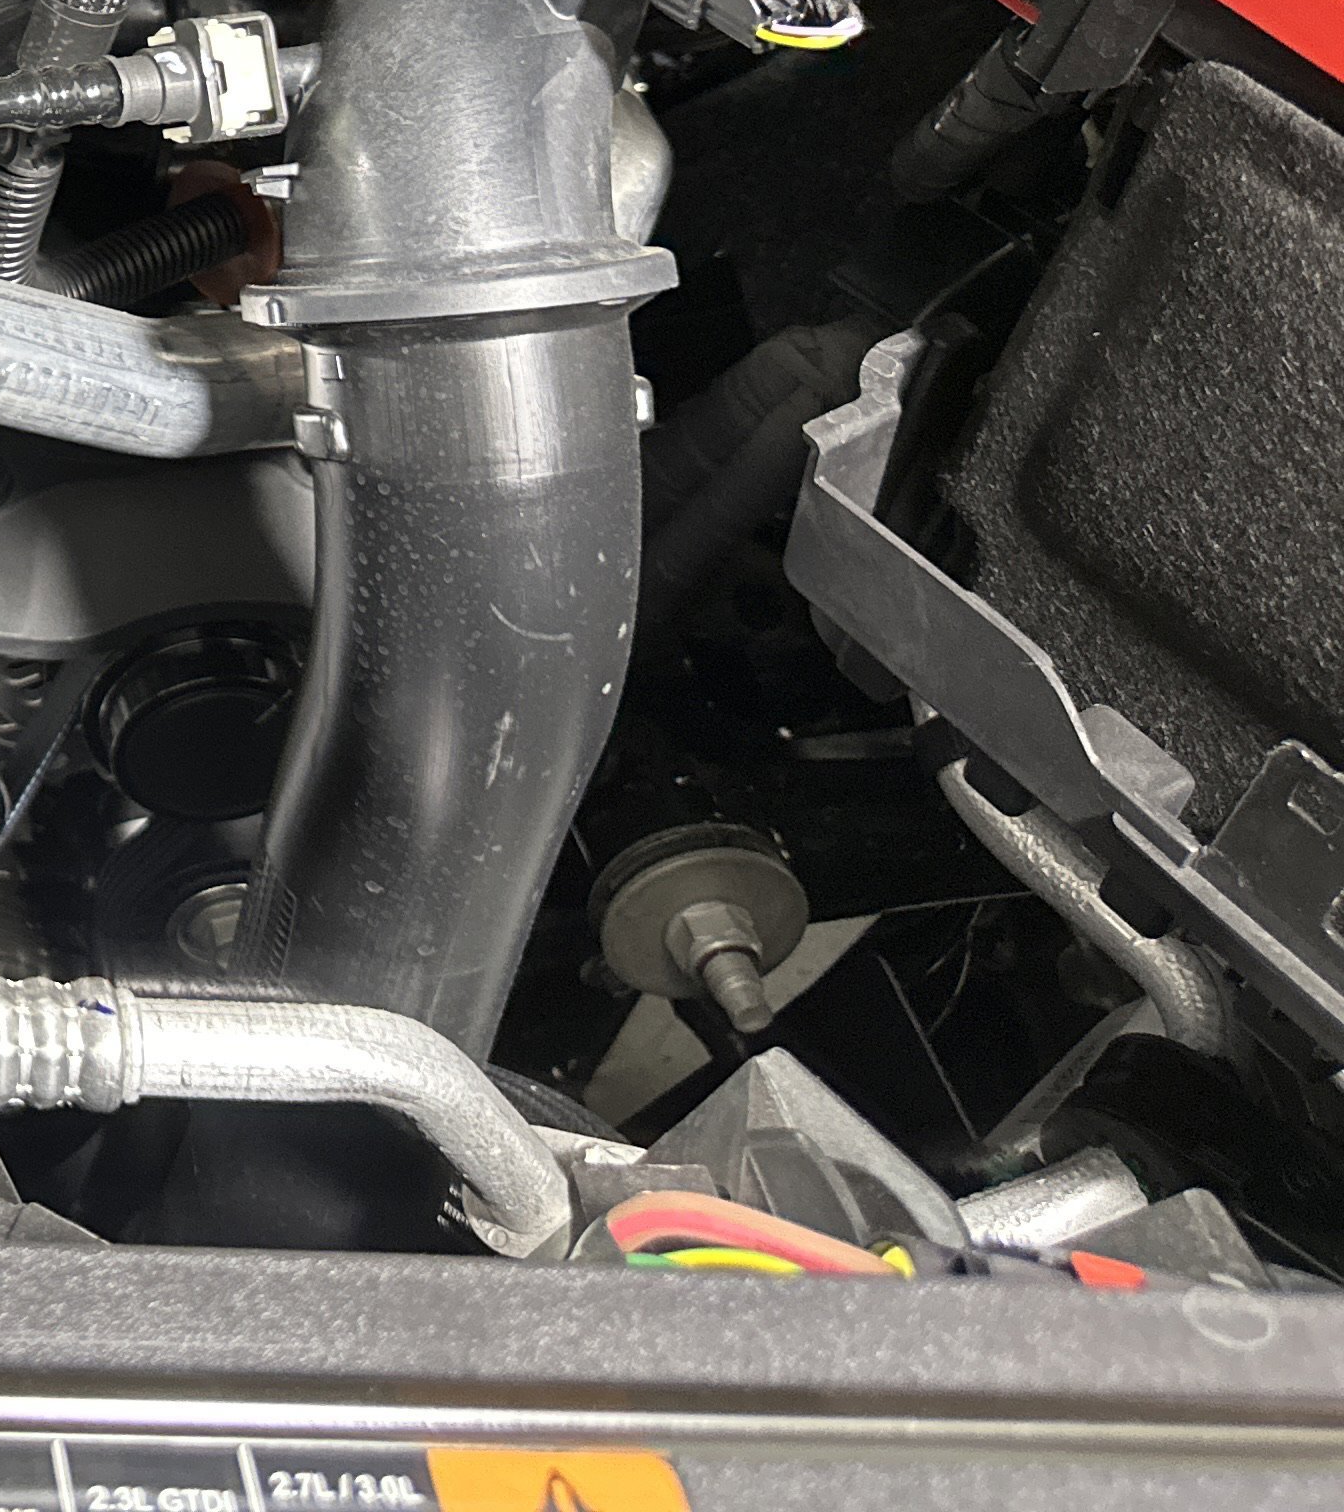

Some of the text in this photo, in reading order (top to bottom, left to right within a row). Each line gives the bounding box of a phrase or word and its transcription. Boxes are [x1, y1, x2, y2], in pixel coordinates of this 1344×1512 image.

[84, 1484, 238, 1512] 2.3L GTDI
[268, 1470, 336, 1501] 2.7L
[354, 1473, 425, 1504] 3.0L
